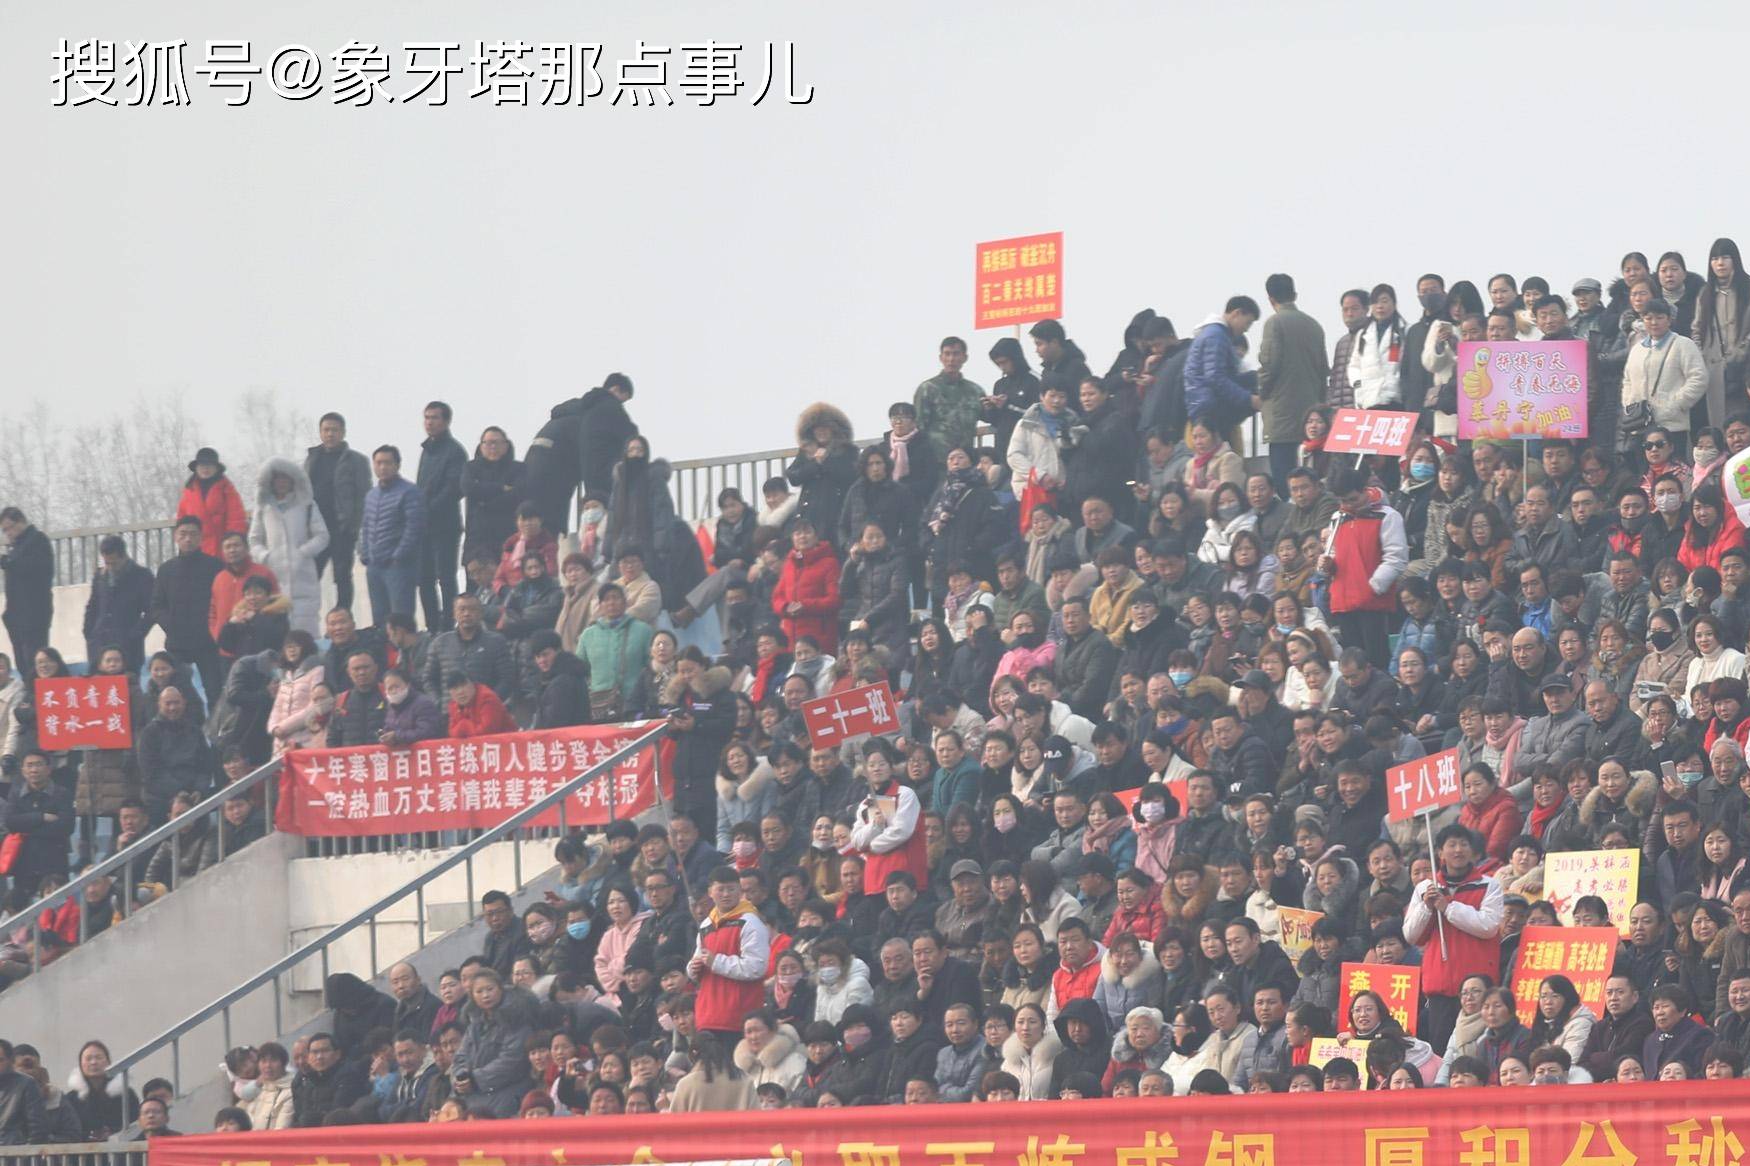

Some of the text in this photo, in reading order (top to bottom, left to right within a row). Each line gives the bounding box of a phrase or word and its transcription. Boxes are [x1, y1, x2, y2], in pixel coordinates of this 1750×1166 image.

[1495, 350, 1567, 373] 拼搏百天
[1335, 414, 1411, 447] 二十四班
[812, 688, 892, 735] 二十一班
[1393, 755, 1458, 811] 十八班
[1566, 940, 1609, 972] 高考必胜
